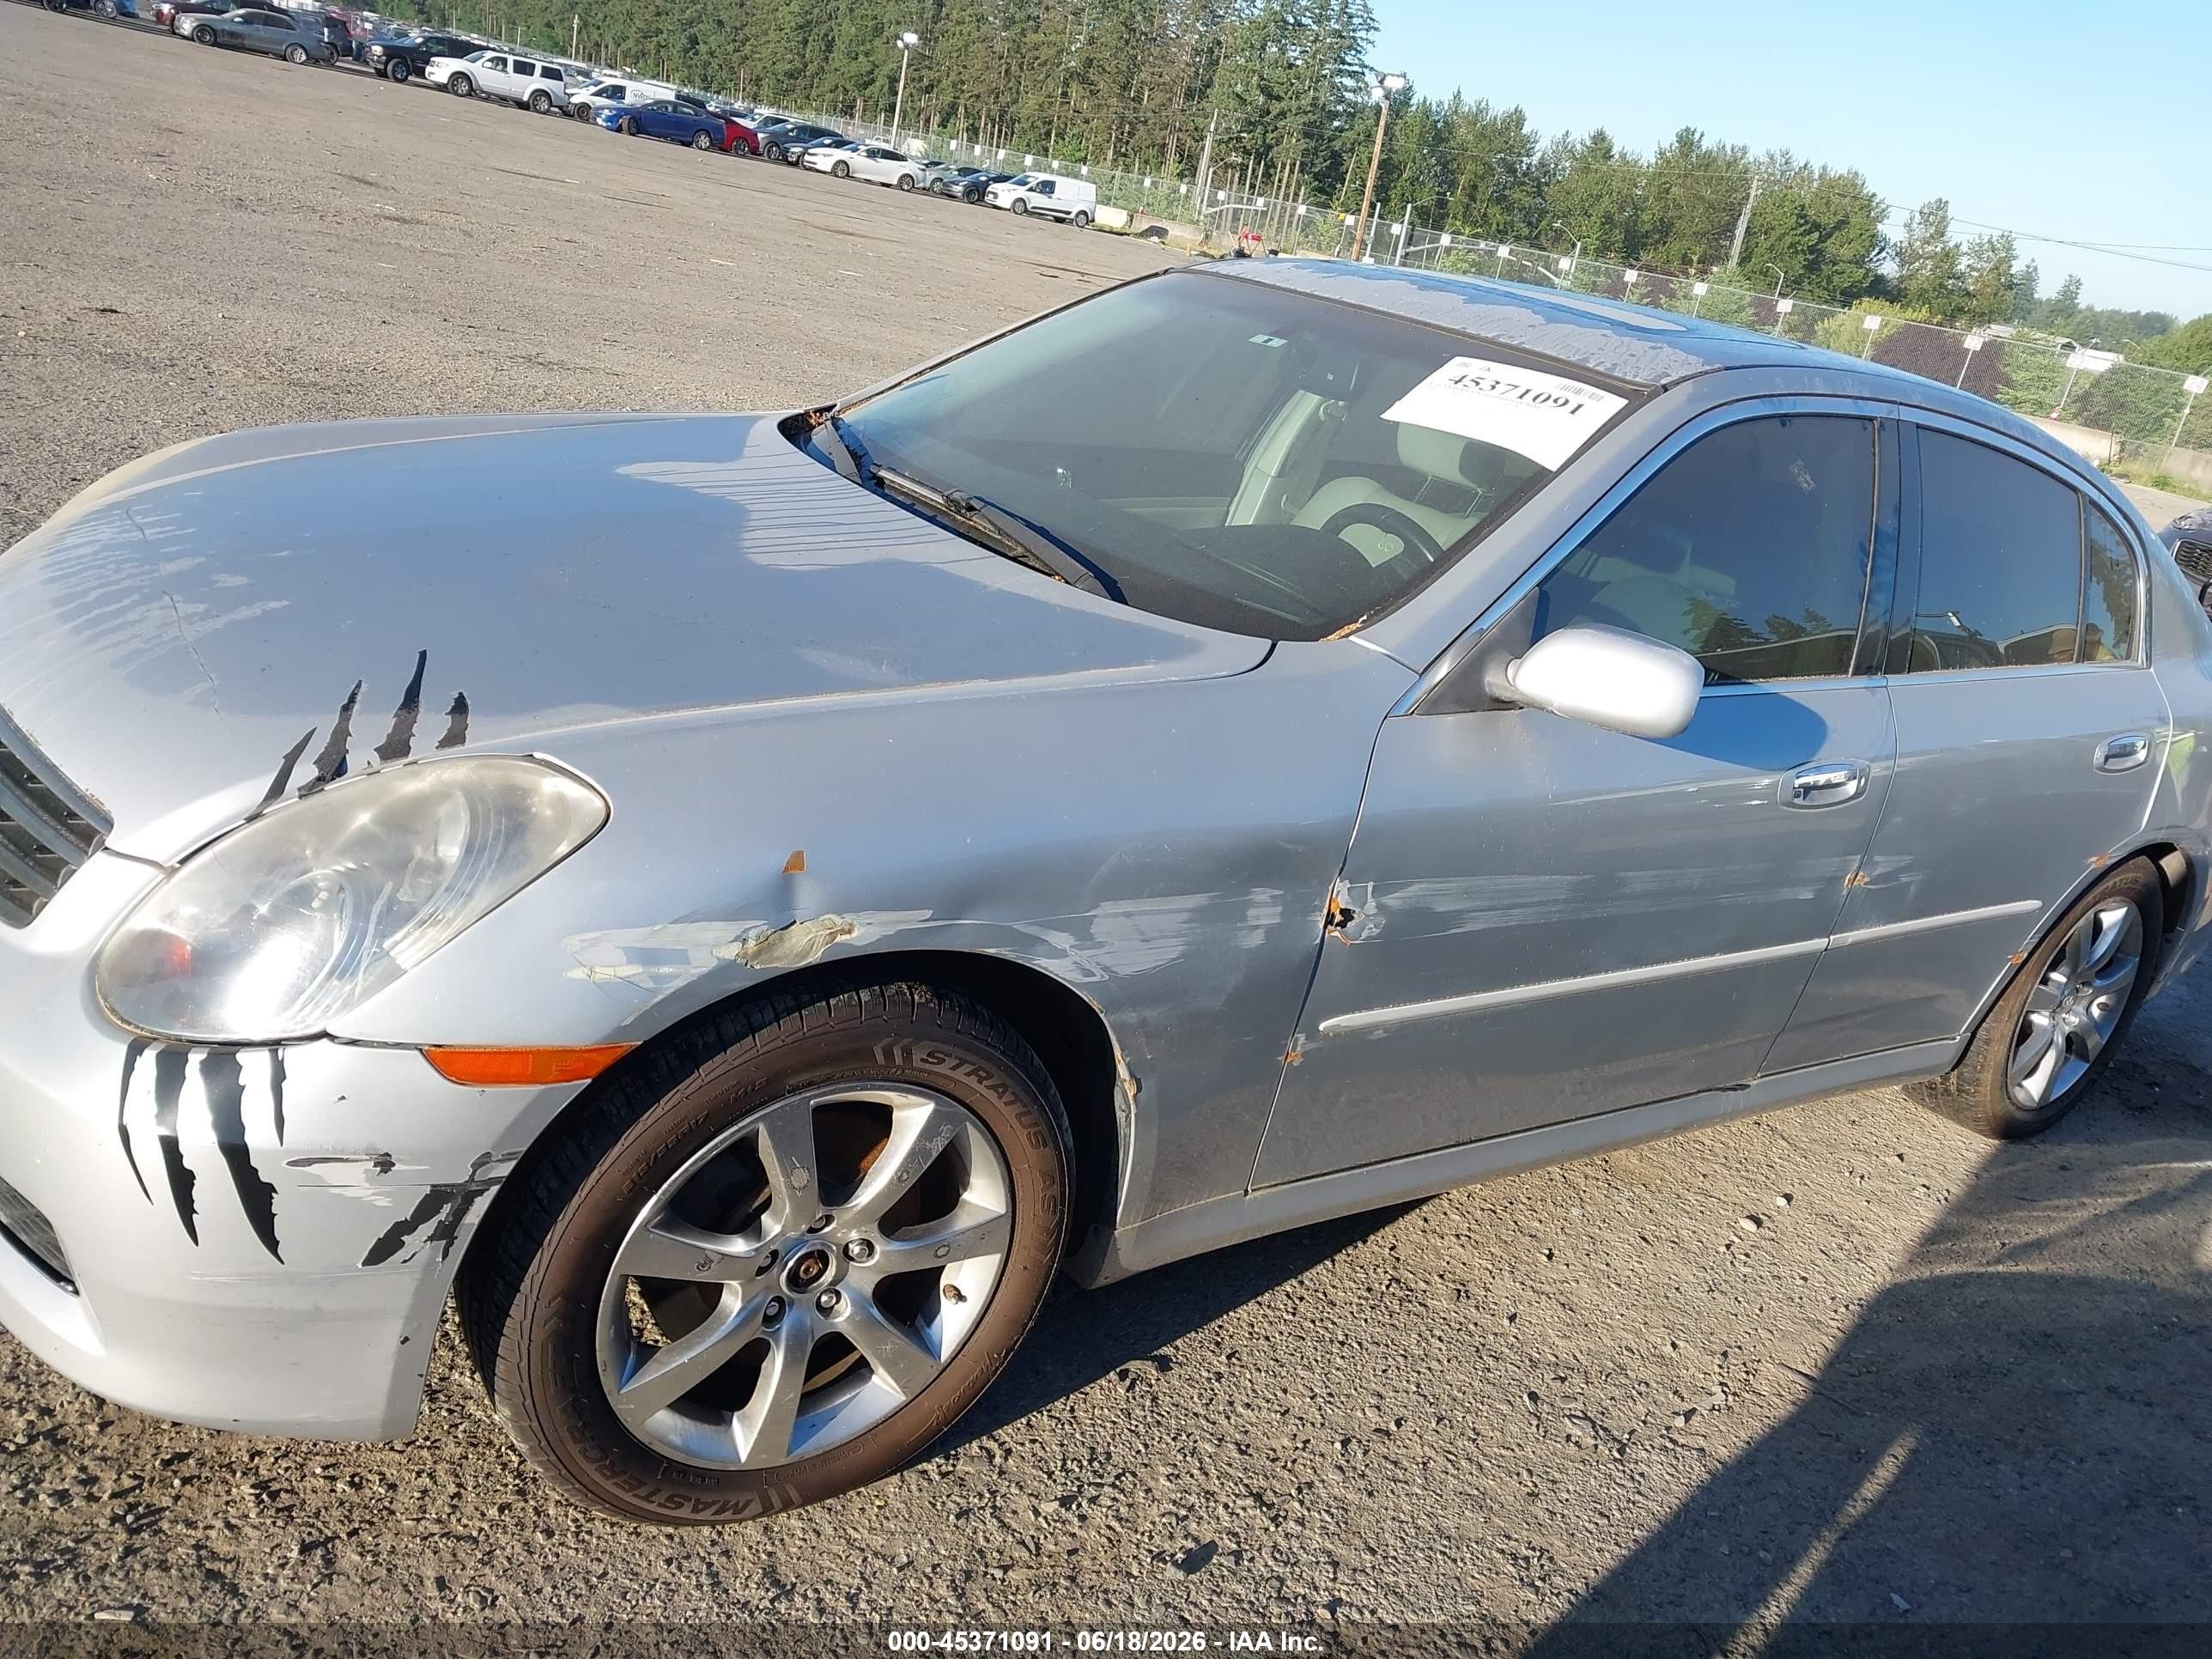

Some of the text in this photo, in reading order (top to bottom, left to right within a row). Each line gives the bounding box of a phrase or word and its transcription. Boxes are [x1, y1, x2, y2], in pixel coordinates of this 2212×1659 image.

[1449, 374, 1585, 416] 45371091
[920, 1049, 1057, 1217] STRATUS AS
